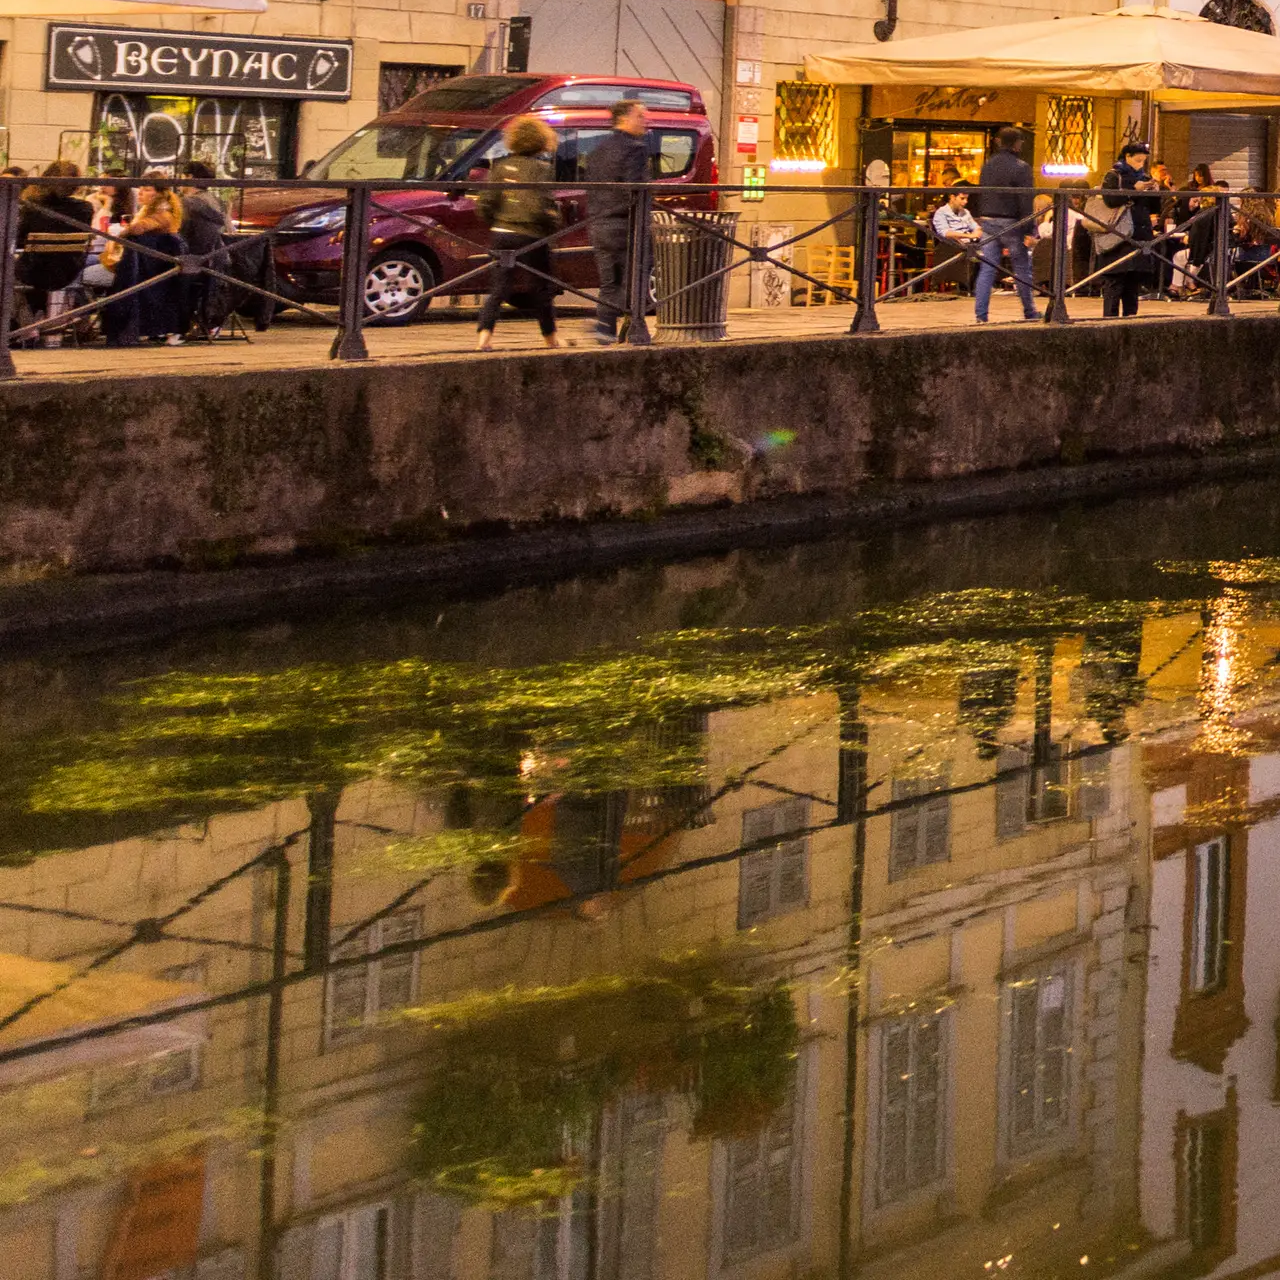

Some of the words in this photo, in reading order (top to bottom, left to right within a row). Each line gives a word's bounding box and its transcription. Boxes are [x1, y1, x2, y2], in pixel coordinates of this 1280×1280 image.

[470, 4, 485, 18] 17
[112, 40, 298, 81] BEYNAC
[914, 86, 999, 117] Vintage
